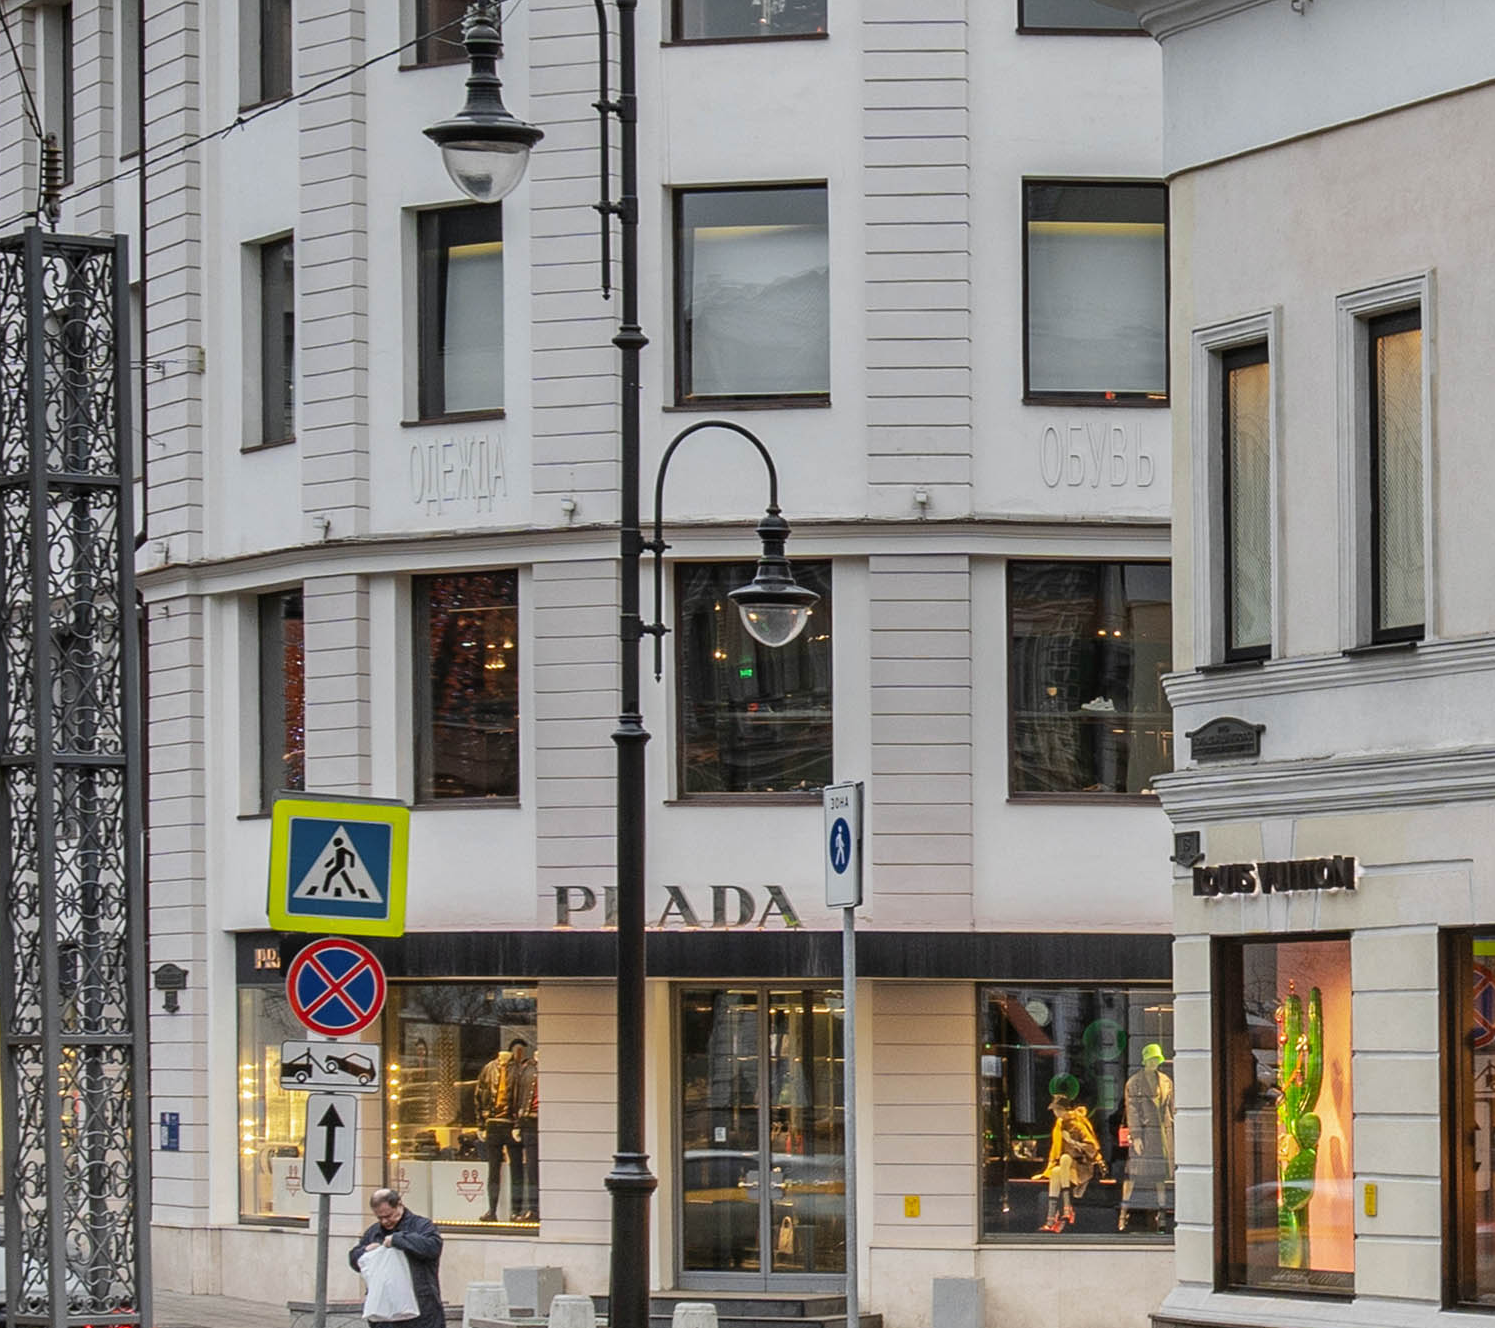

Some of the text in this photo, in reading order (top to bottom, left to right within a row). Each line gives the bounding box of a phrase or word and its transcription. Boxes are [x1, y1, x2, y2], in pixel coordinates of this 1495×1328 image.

[407, 433, 509, 518] ОДЕЖДА
[1038, 420, 1156, 490] ОБУВЬ
[829, 795, 849, 811] ЗОНА
